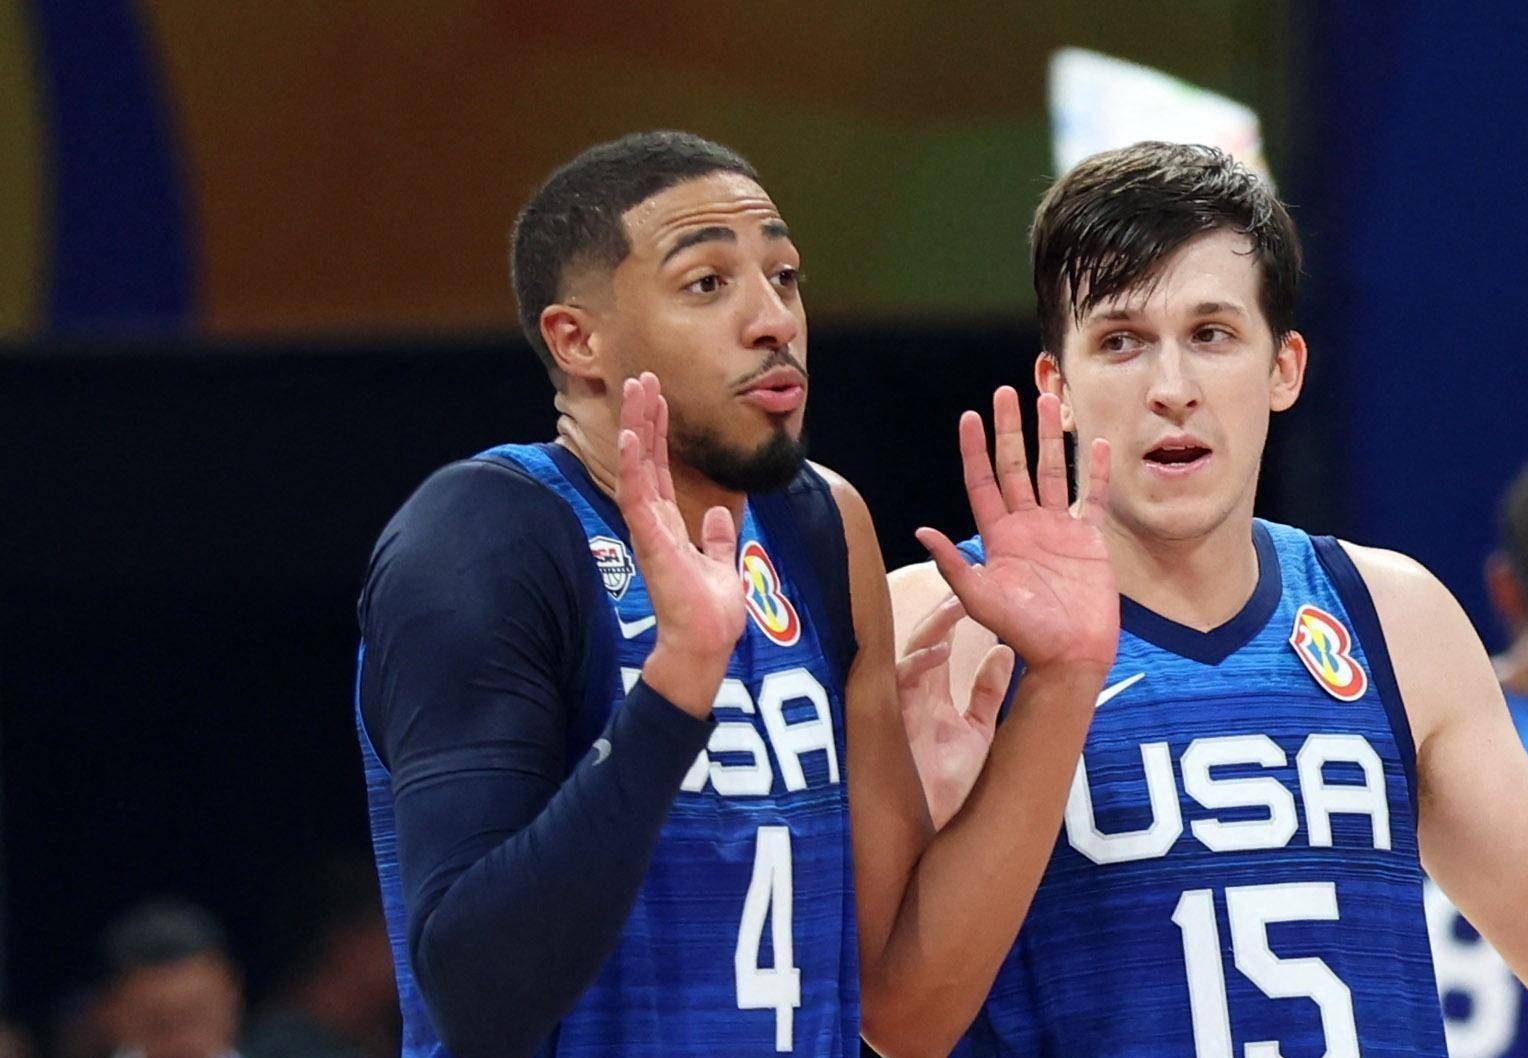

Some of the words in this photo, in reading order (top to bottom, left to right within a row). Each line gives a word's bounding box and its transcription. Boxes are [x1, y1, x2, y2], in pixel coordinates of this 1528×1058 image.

[622, 667, 839, 796] SA
[1064, 733, 1391, 865] USA
[734, 826, 800, 1052] 4
